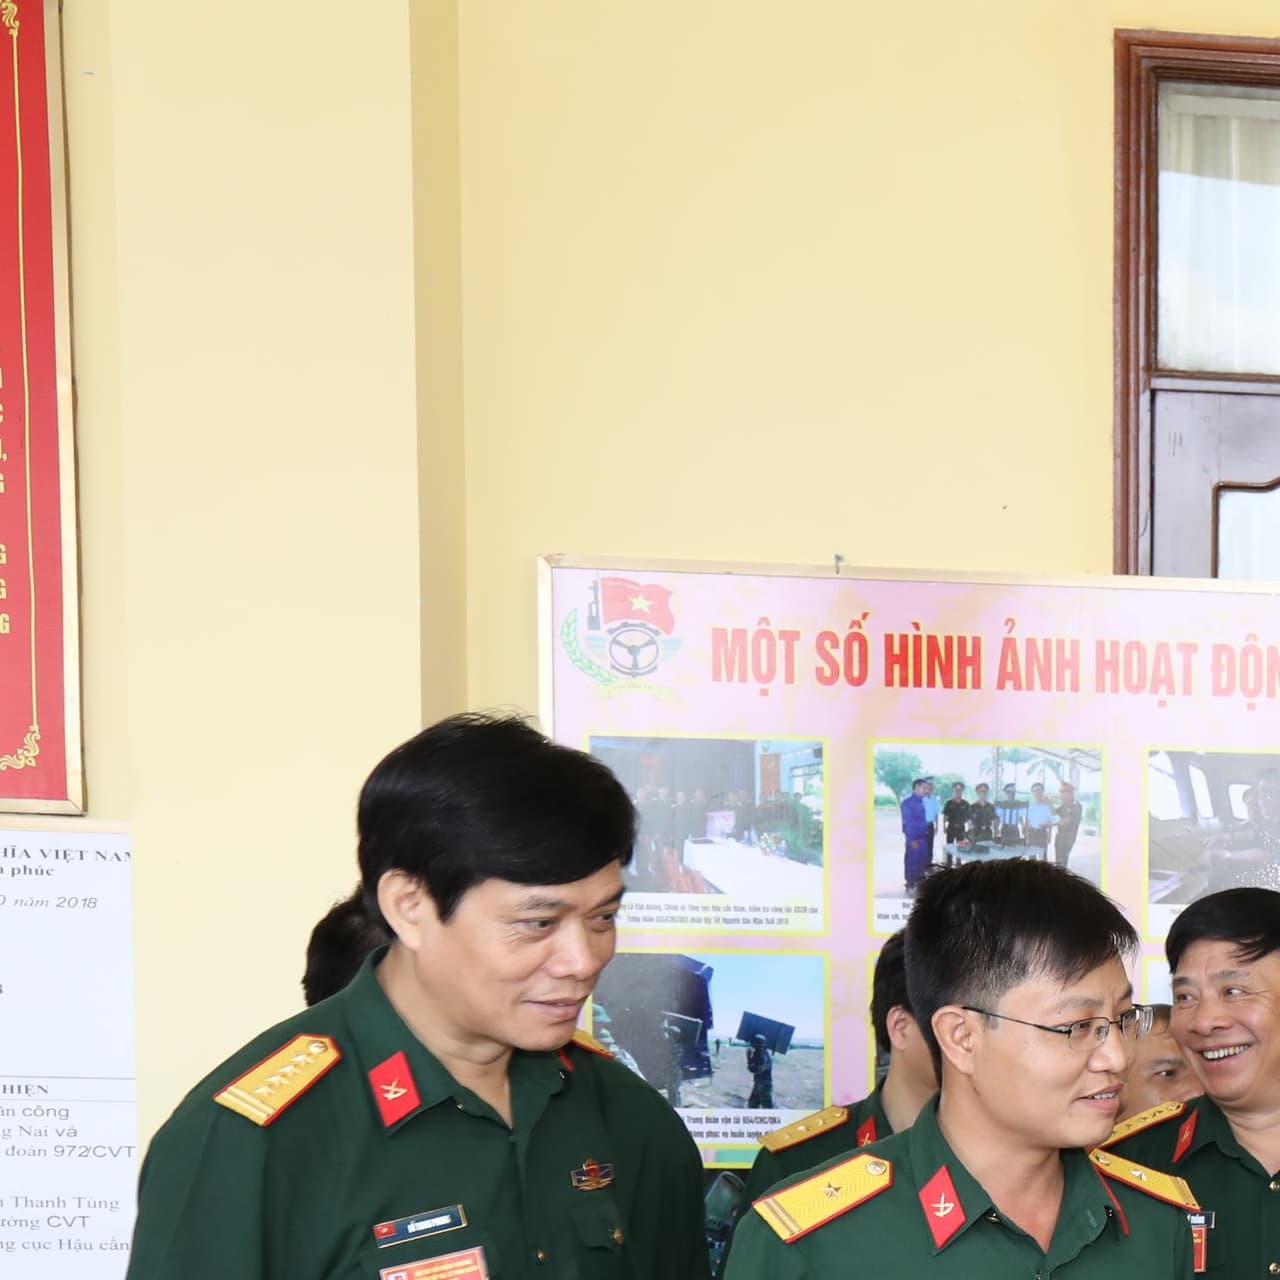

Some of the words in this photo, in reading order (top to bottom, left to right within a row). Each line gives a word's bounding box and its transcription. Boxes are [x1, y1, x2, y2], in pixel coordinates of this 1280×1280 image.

[710, 617, 800, 697] MỘT
[815, 612, 870, 688] SỐ
[884, 620, 982, 690] HÌNH
[997, 617, 1080, 694] ẢNH
[1095, 638, 1198, 709] HOẠT
[39, 848, 89, 863] VIỆT
[11, 864, 55, 877] phúc
[56, 896, 98, 908] 2018
[22, 1105, 70, 1120] công
[18, 1125, 48, 1137] Nai
[55, 1126, 78, 1137] và
[54, 1144, 136, 1158] 972/CVT
[10, 1196, 66, 1208] Thanh
[73, 1197, 120, 1212] Tùng
[47, 1215, 90, 1228] CVT
[58, 1238, 93, 1253] Hậu
